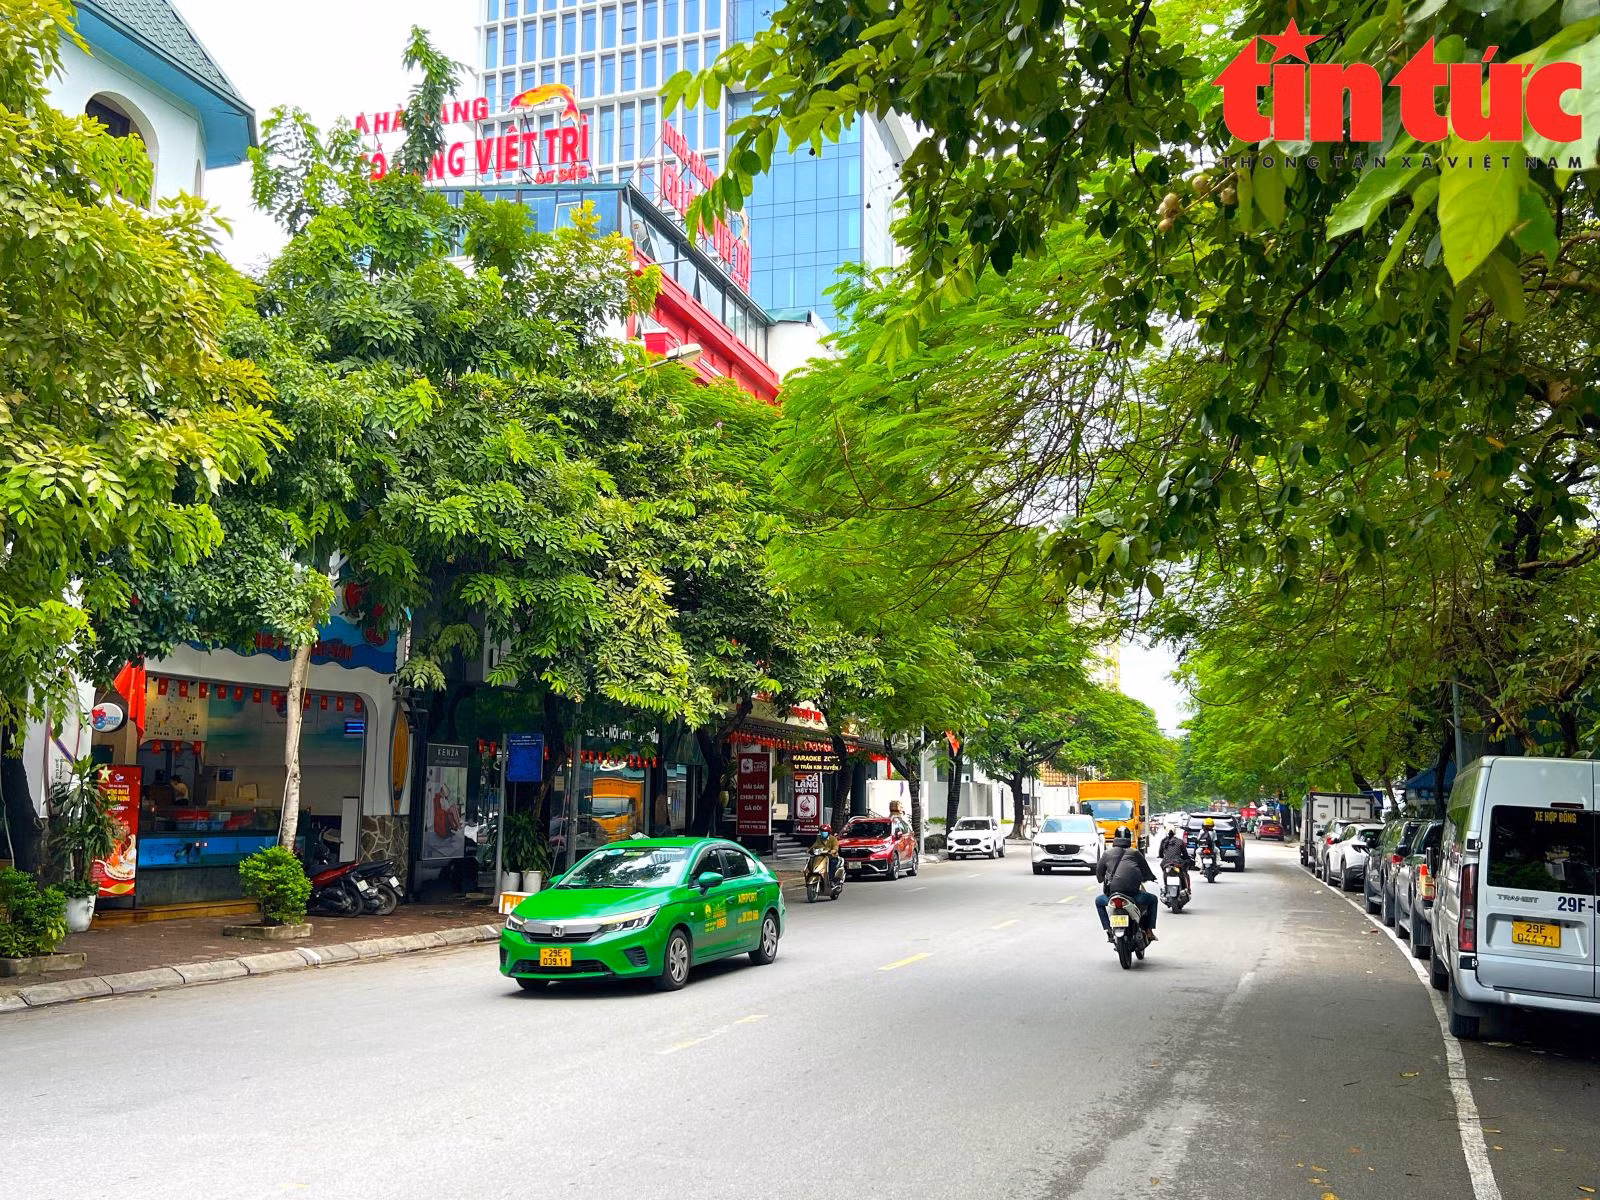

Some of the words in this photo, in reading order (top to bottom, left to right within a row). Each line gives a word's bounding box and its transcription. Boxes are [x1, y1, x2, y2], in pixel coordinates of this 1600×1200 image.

[475, 124, 538, 179] VIỆT
[544, 113, 589, 165] TRÌ
[792, 754, 822, 762] KARAOKE
[795, 780, 819, 788] LĂNG
[1534, 811, 1543, 822] XE
[1496, 893, 1540, 904] TRANSIT
[1526, 923, 1546, 934] 29F
[548, 949, 563, 957] 29E
